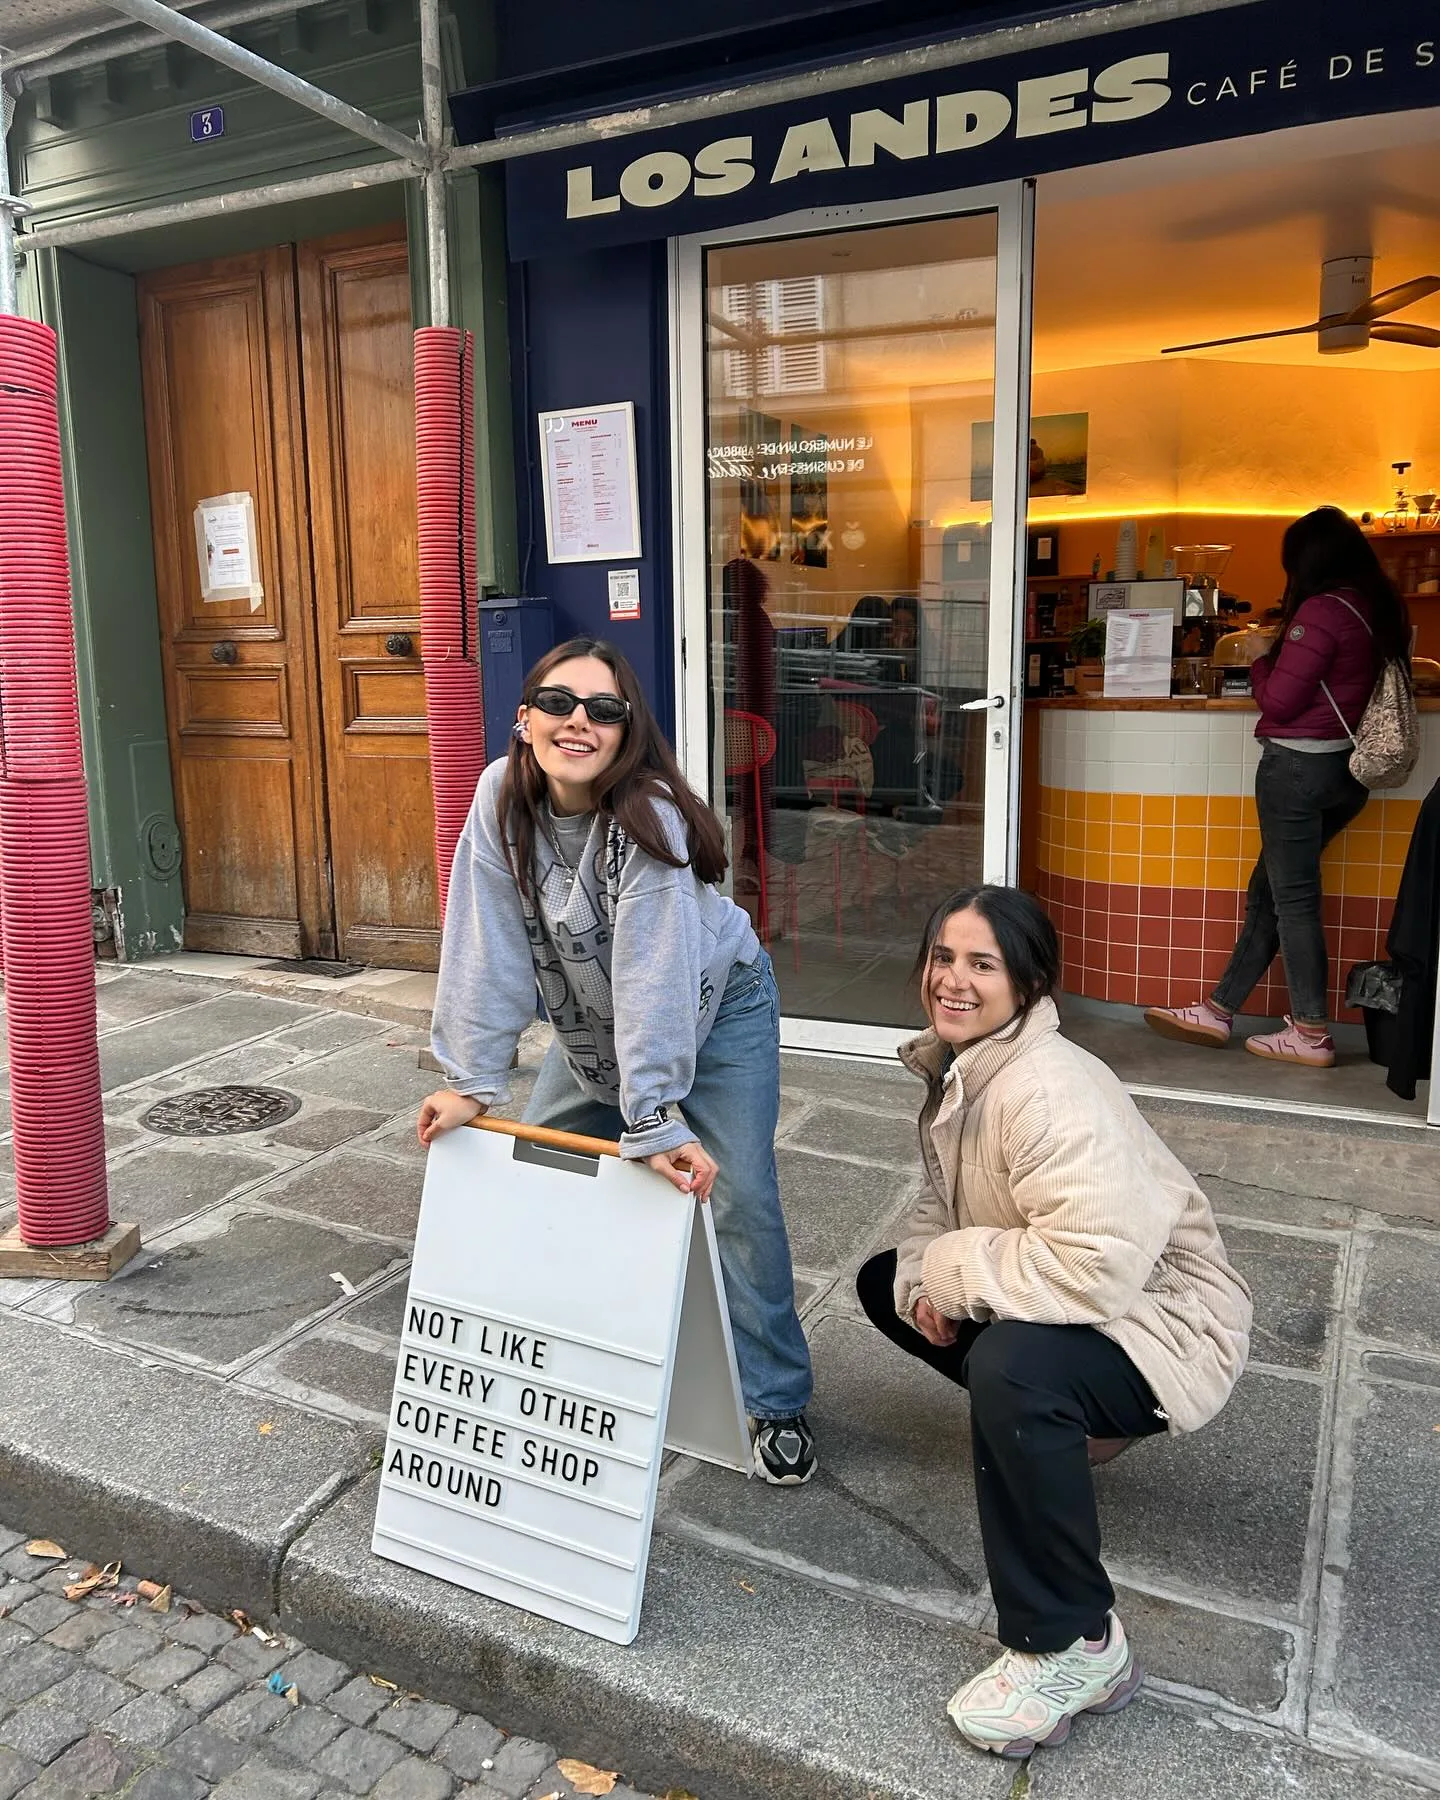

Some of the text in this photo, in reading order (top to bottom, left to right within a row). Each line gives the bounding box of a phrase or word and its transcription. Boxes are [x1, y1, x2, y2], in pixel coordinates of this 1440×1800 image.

[1187, 59, 1298, 105] CAFÉ
[1329, 48, 1385, 80] DE
[202, 112, 212, 135] 3
[566, 52, 1172, 219] LOS ANDES
[571, 419, 598, 428] MENU
[407, 1306, 548, 1370] NOT LIKE
[403, 1353, 617, 1442] EVERY OTHER
[396, 1400, 600, 1487] COFFEE SHOP
[388, 1448, 502, 1508] AROUND
